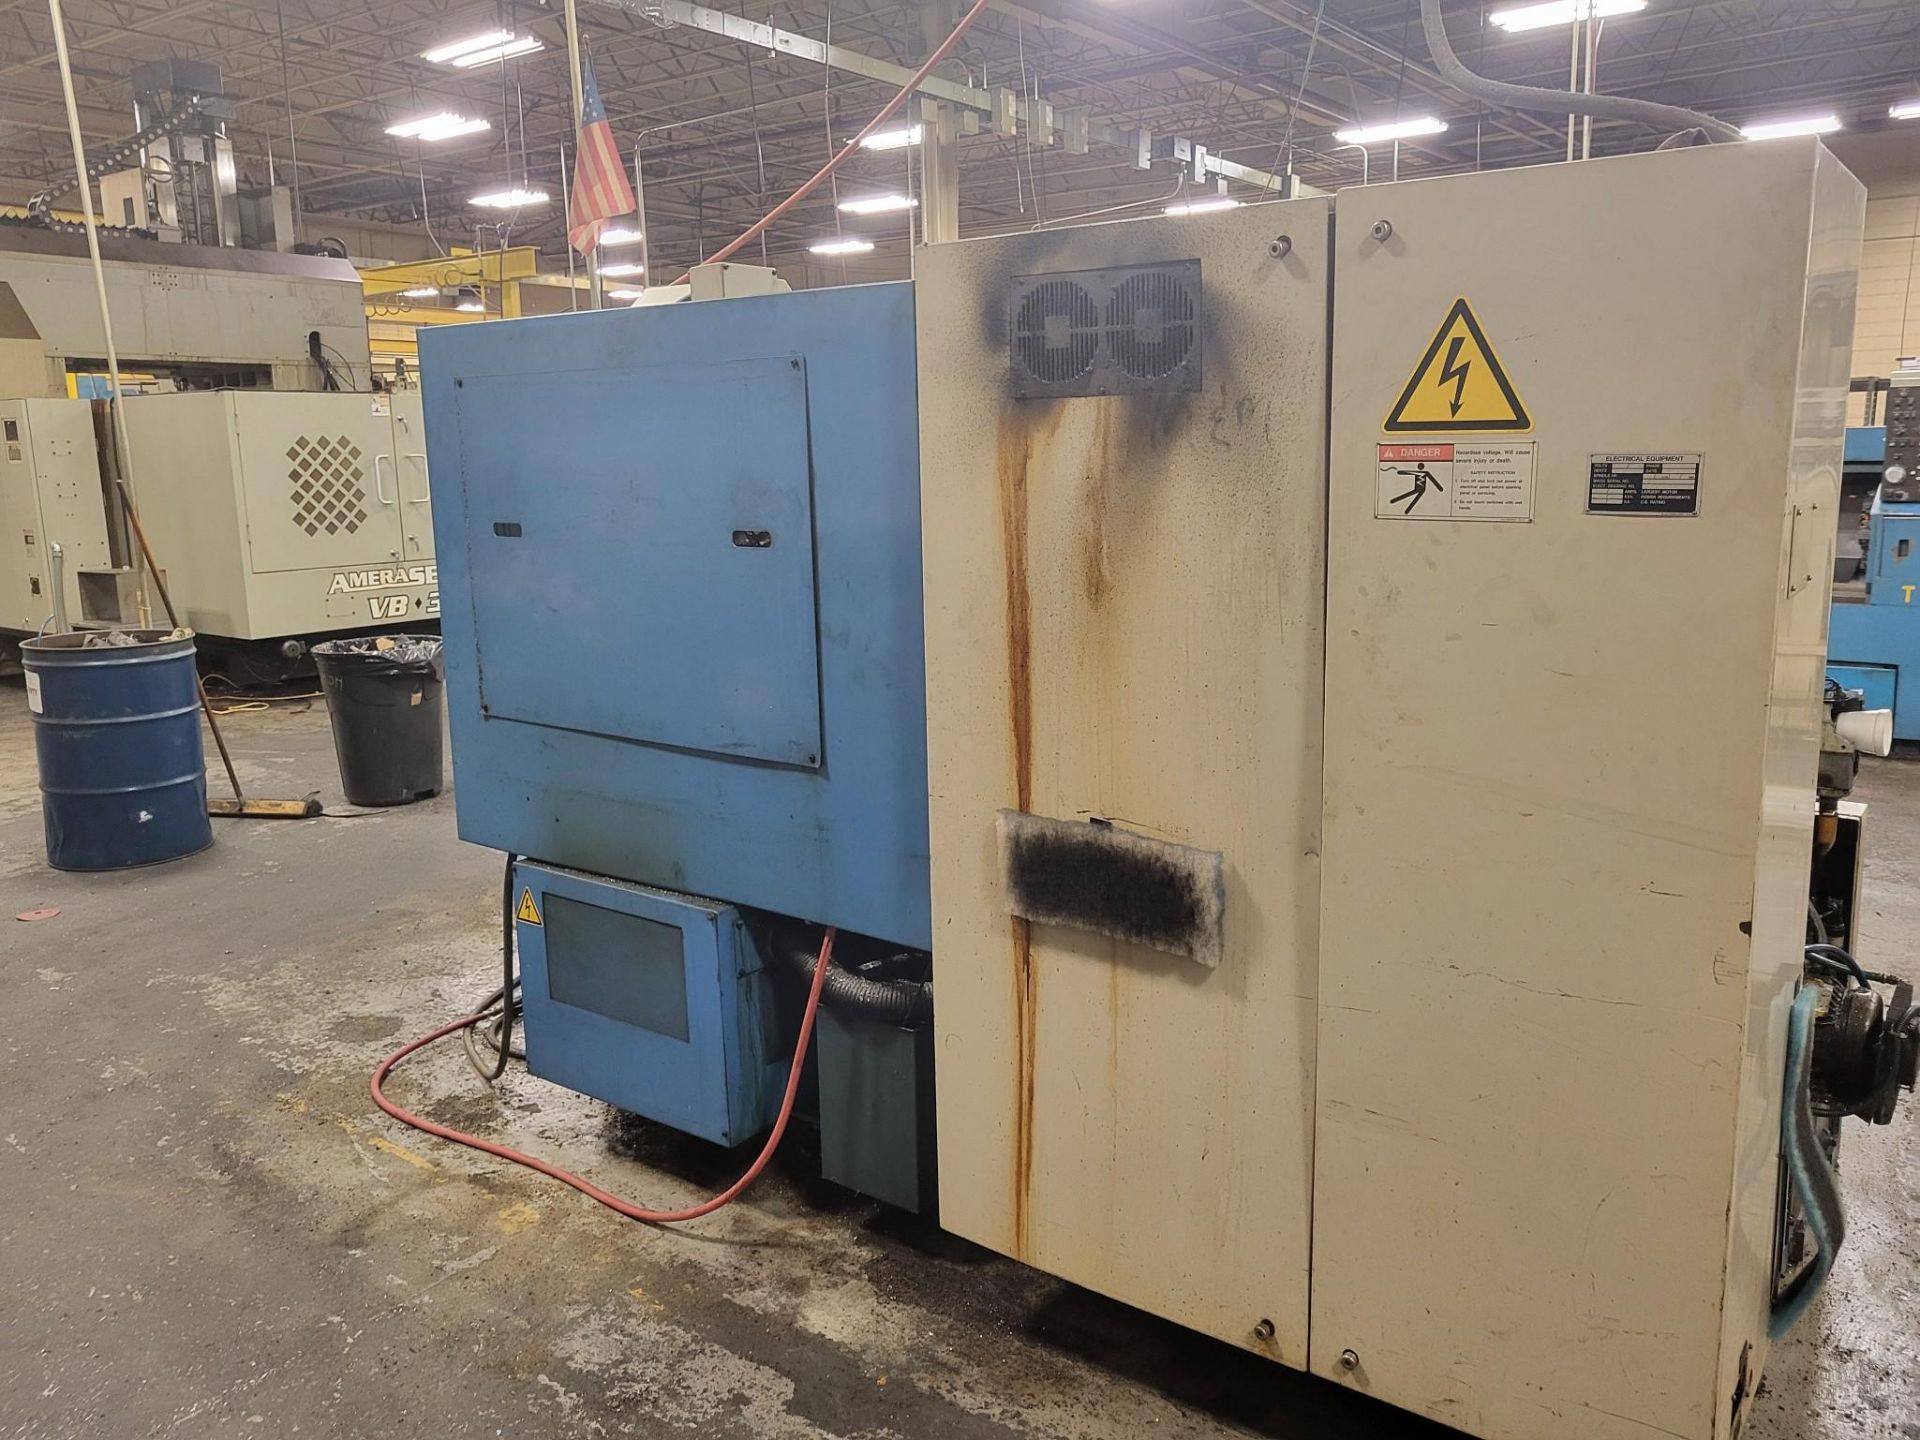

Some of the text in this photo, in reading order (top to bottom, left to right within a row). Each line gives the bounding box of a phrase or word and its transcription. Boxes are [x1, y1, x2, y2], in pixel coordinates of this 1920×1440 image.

[1400, 448, 1441, 457] DANGER
[1901, 585, 1916, 603] T
[367, 593, 410, 620] VB
